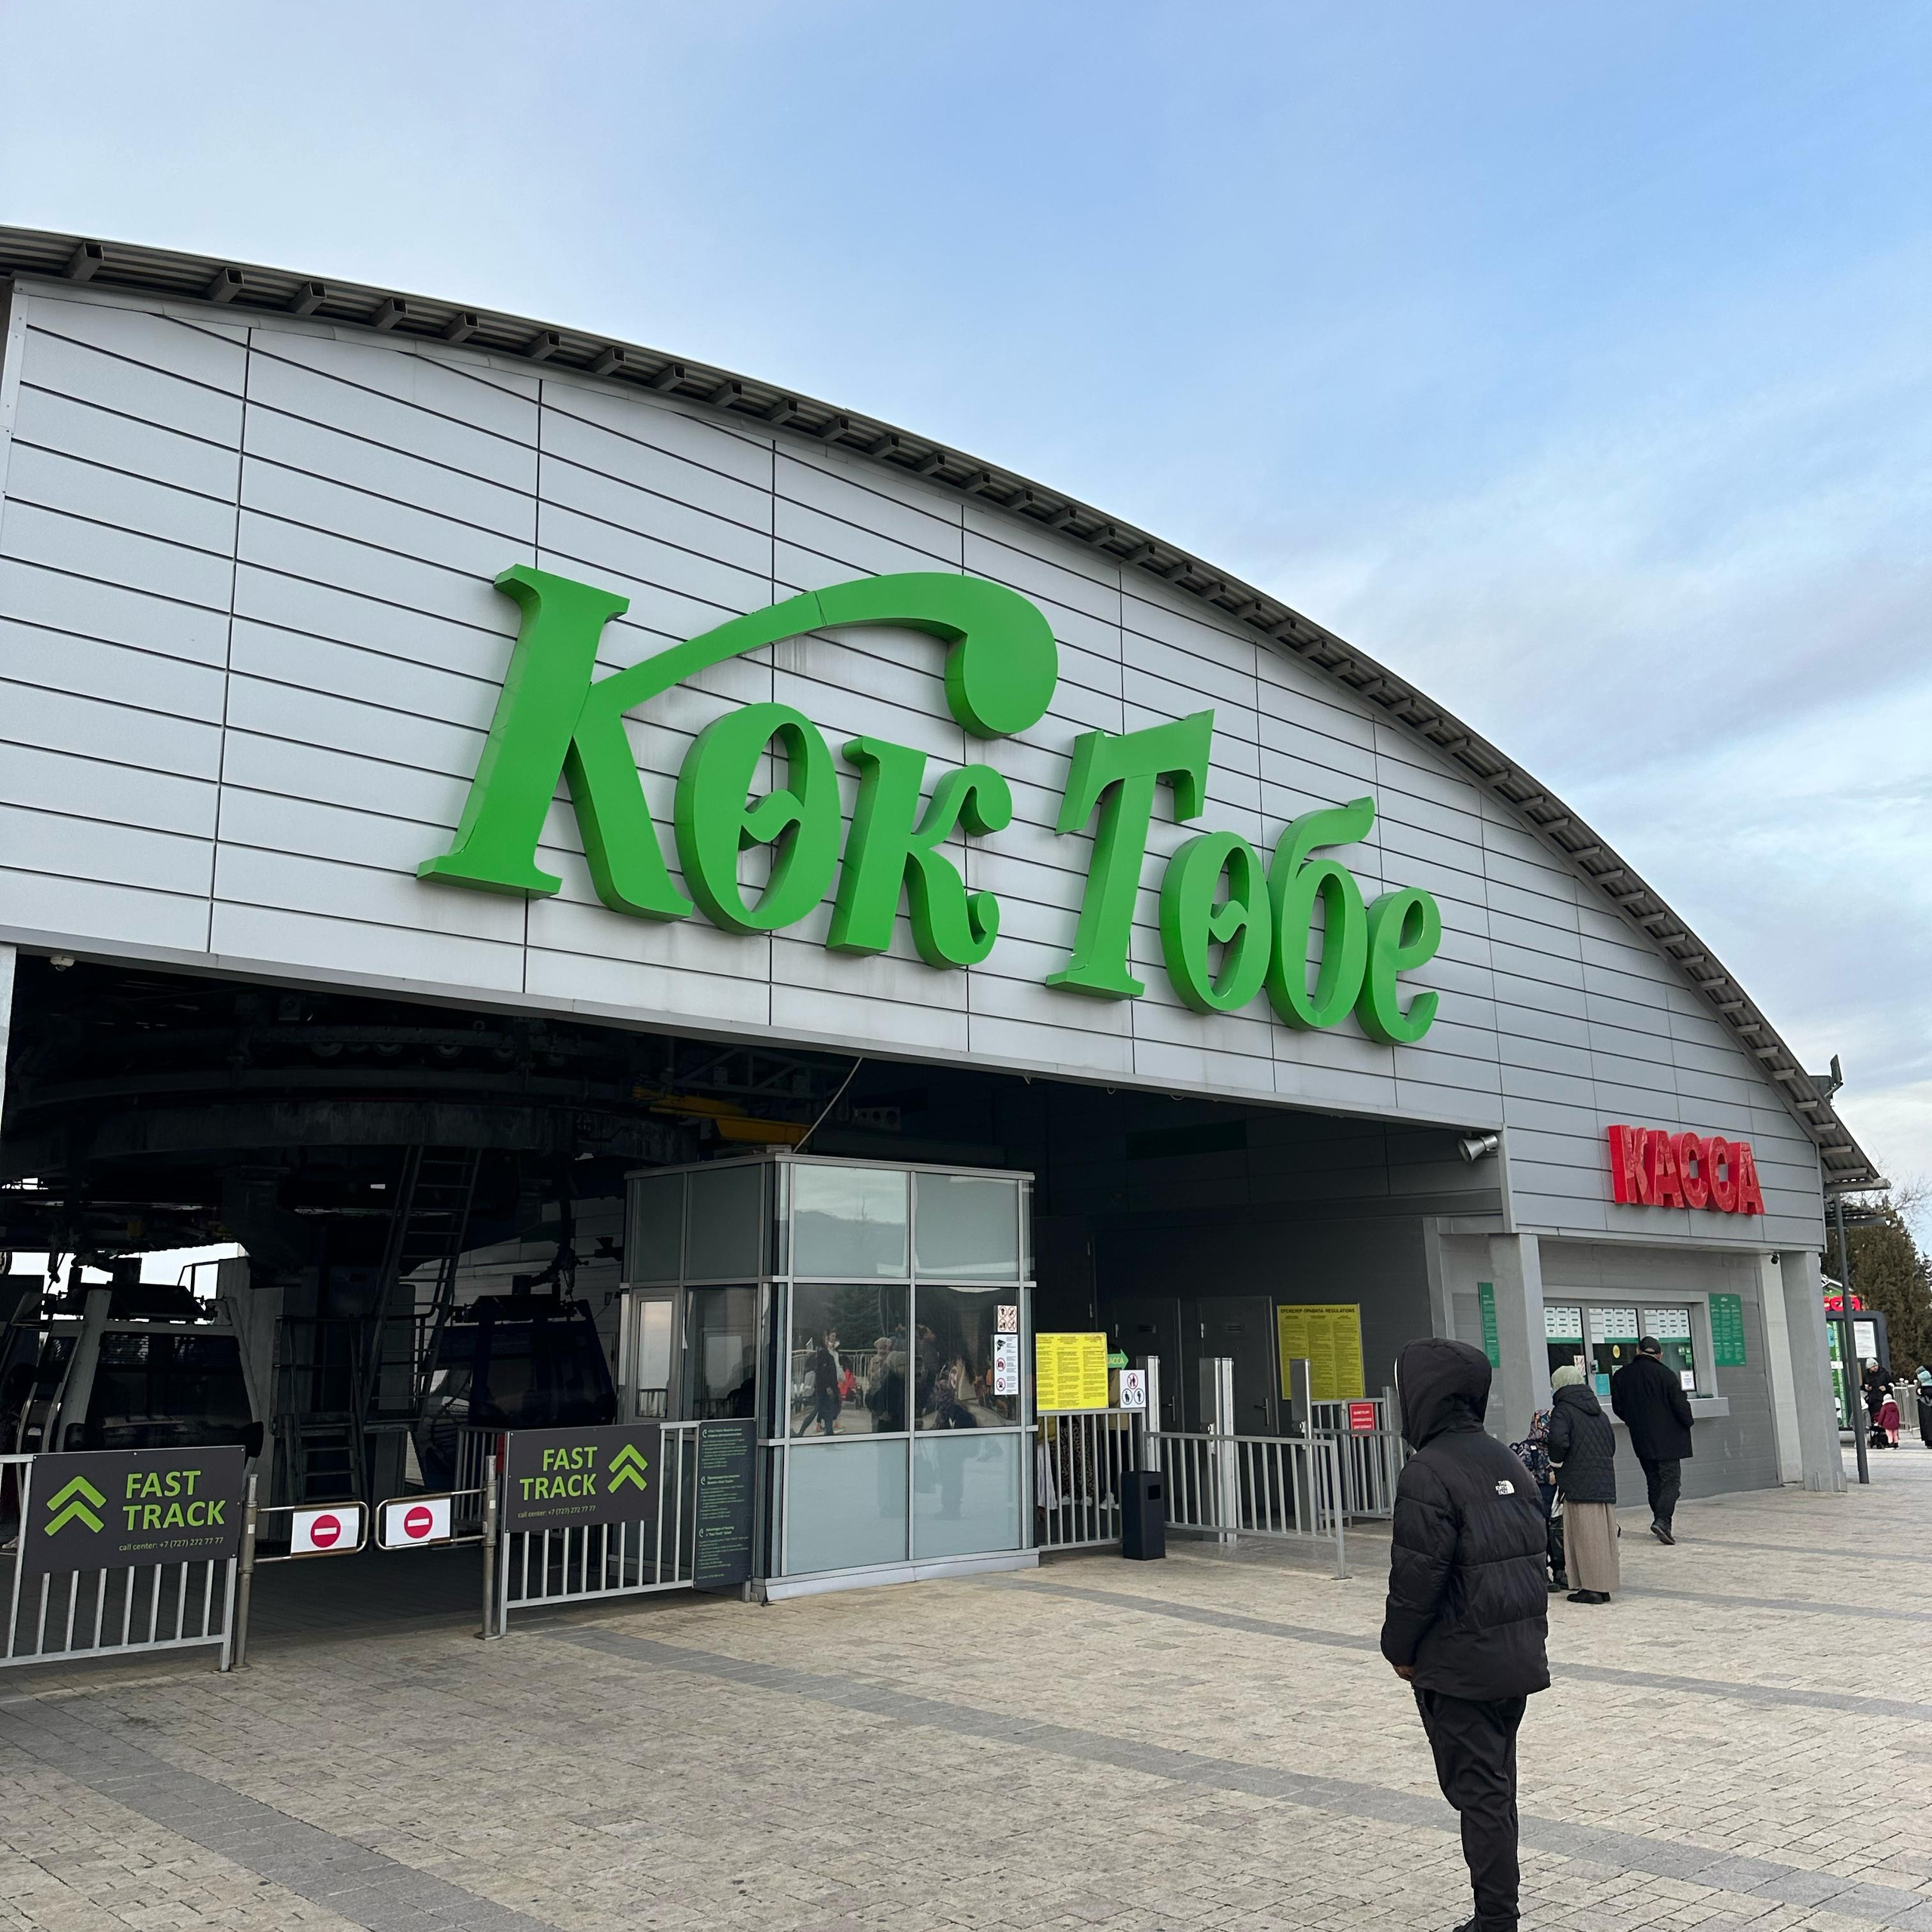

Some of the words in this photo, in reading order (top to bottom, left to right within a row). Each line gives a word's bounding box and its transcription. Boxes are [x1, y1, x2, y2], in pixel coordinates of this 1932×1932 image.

[417, 564, 1058, 969] Көк
[1046, 709, 1441, 1044] Төбе
[1607, 1124, 1766, 1215] КАССА
[543, 1446, 598, 1472] FAST
[126, 1470, 202, 1499] FAST
[519, 1473, 597, 1500] TRACK
[122, 1500, 226, 1531] TRACK
[555, 1508, 570, 1516] (727)
[118, 1543, 131, 1551] call
[132, 1542, 158, 1550] center:
[170, 1539, 189, 1549] (727)
